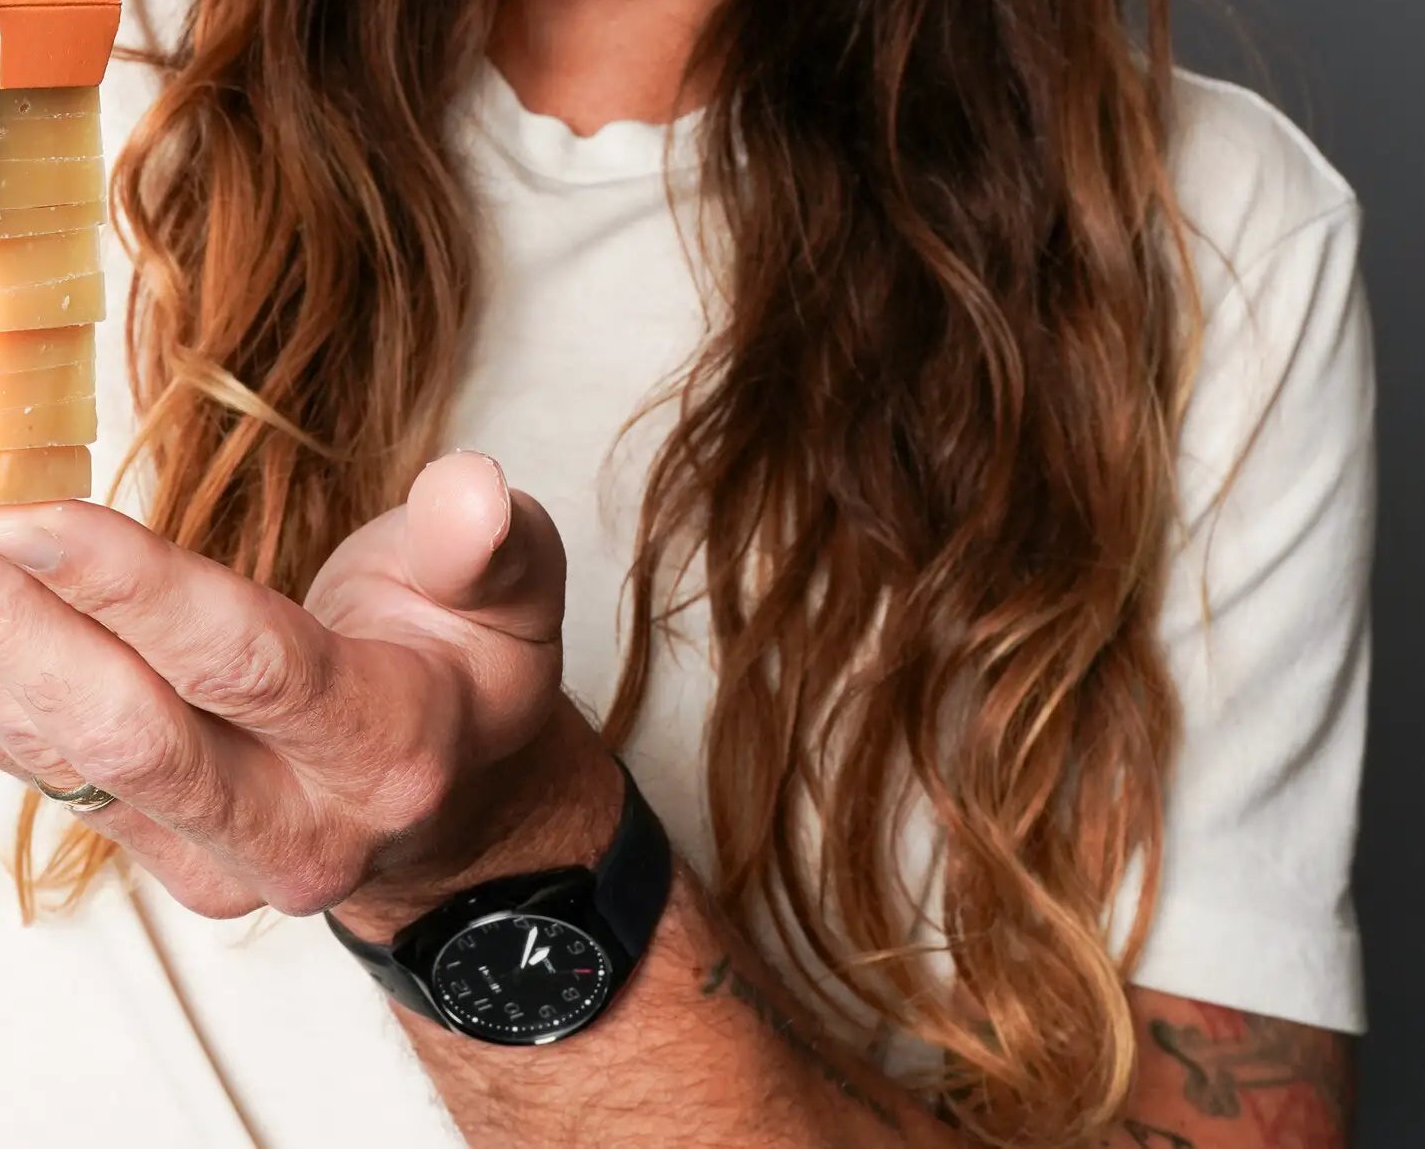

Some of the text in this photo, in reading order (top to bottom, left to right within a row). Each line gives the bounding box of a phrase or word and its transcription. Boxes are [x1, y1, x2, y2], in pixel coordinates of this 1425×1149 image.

[450, 979, 472, 999] 12
[474, 998, 493, 1011] 11
[504, 1002, 524, 1021] 10
